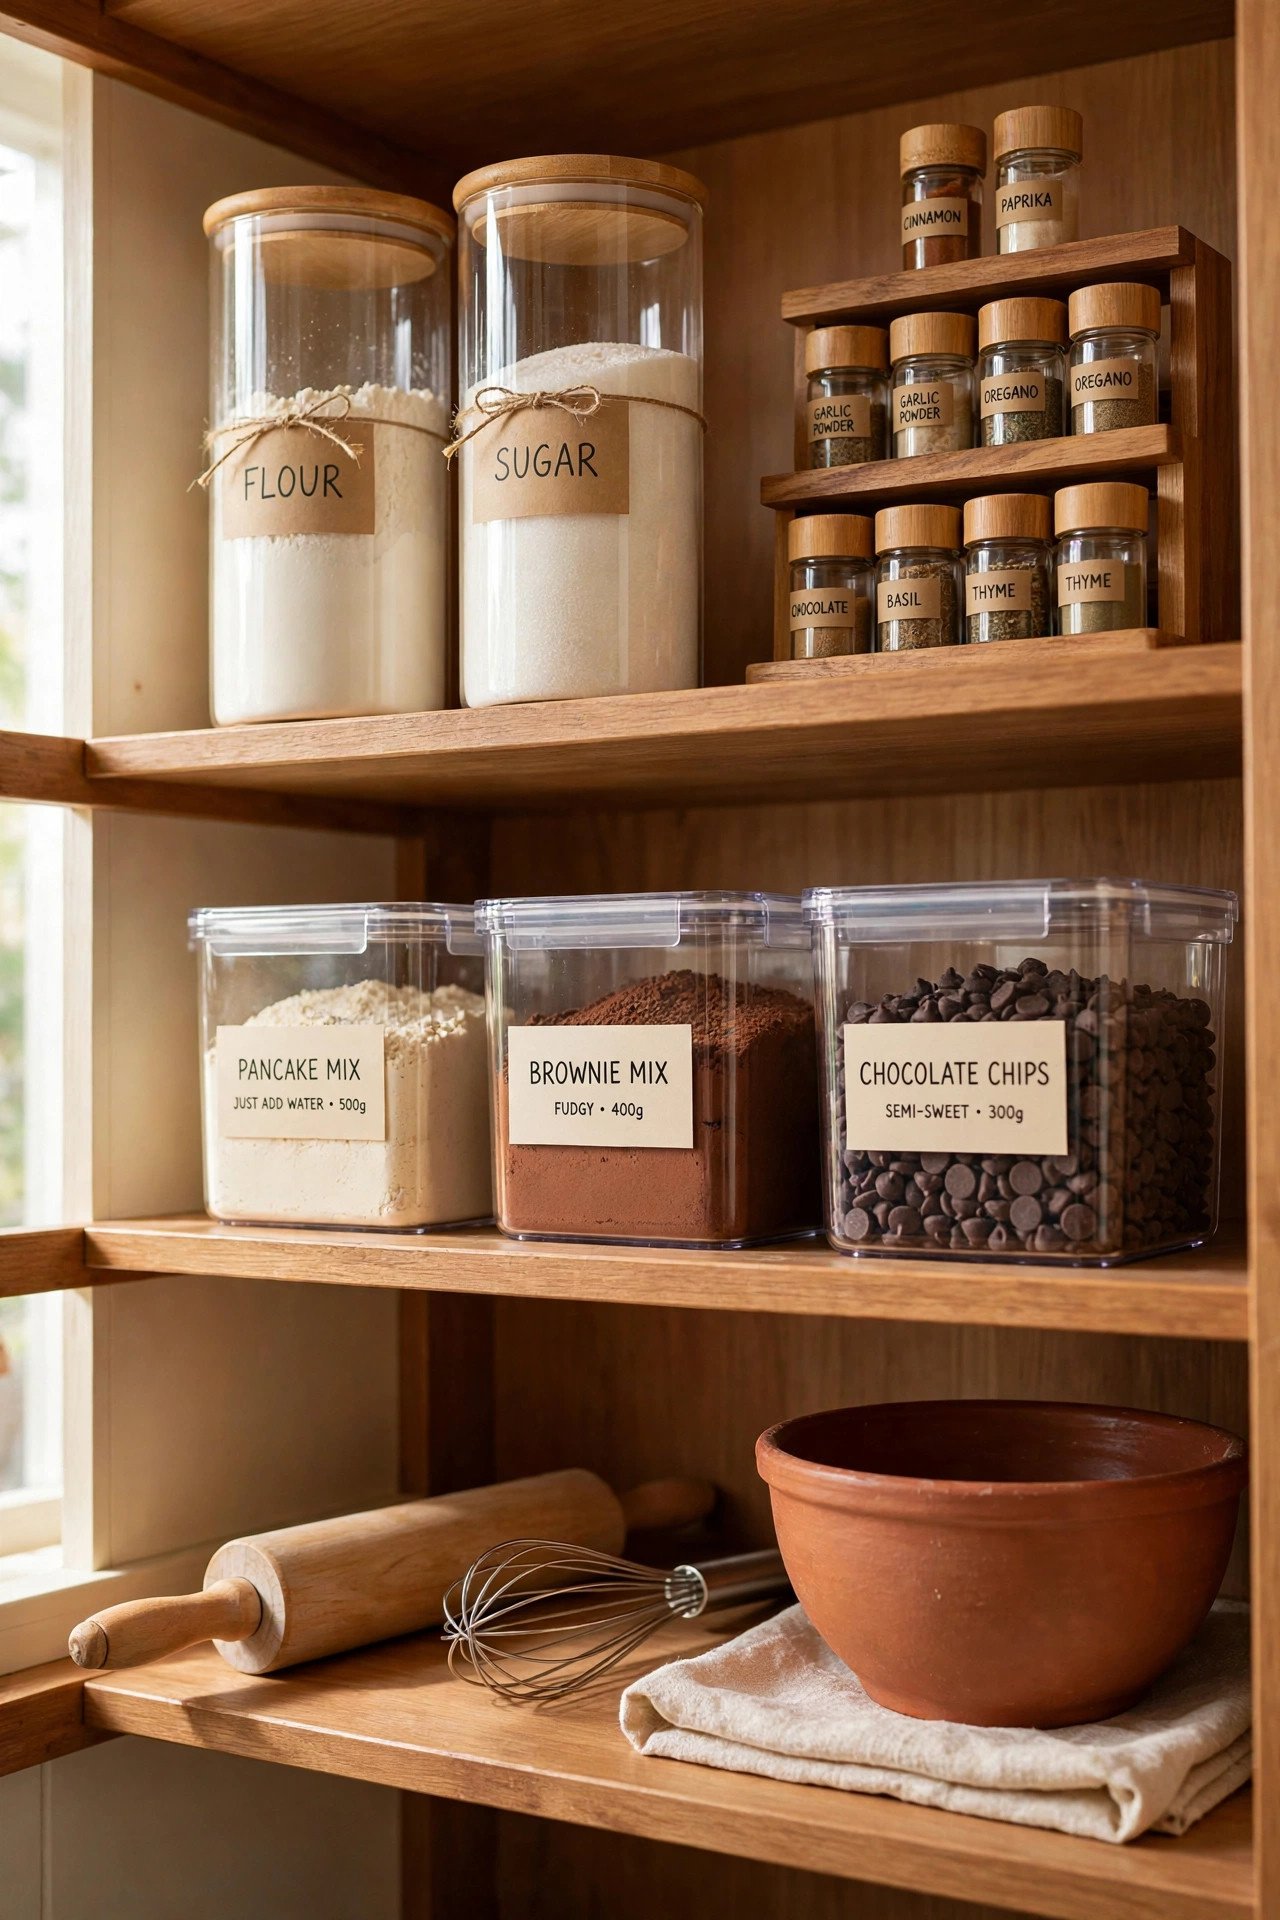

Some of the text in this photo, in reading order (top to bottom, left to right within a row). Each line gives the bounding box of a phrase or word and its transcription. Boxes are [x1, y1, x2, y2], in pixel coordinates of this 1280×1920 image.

[1001, 191, 1053, 213] PAPRIKA
[903, 209, 962, 231] CINNAMON
[1075, 371, 1133, 392] OREGANO
[900, 391, 940, 407] GARLIC
[984, 384, 1039, 404] OREGANO
[813, 404, 852, 420] GARLIC
[900, 405, 941, 422] POWDER
[813, 419, 854, 435] POWDER
[495, 442, 599, 482] SUGAR
[244, 464, 343, 502] FLOUR
[973, 582, 1016, 600] THYME
[1066, 572, 1111, 590] THYME
[887, 592, 921, 608] BASIL
[238, 1058, 361, 1081] PANCAKE MIX
[530, 1060, 669, 1085] BROWNIE MIX
[859, 1061, 1050, 1086] CHOCOLATE CHIPS
[233, 1096, 366, 1115] JUST ADD WATER 500g
[554, 1101, 644, 1121] FUDGY 400g
[885, 1103, 1024, 1124] SEMI-SWEET 300g
